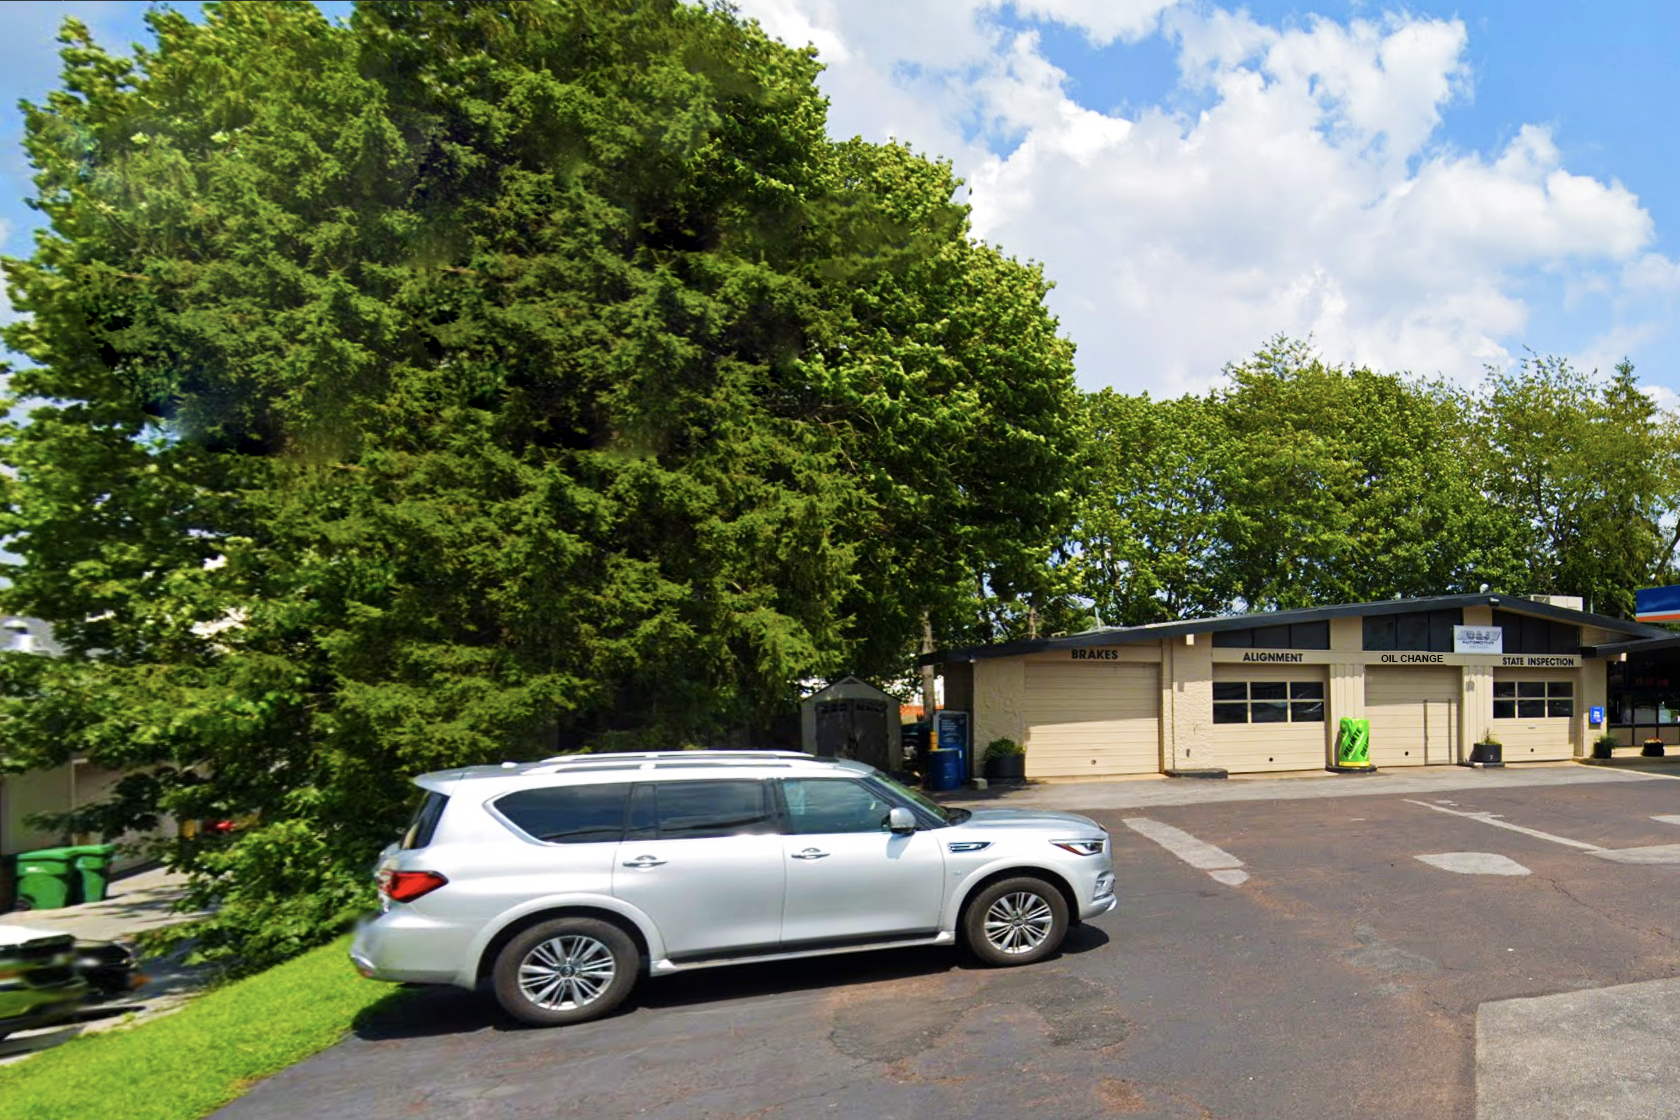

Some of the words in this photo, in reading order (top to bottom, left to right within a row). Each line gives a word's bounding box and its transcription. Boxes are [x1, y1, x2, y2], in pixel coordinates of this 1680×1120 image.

[1071, 649, 1119, 660] BRAKES
[1243, 652, 1303, 662] ALIGNMENT
[1381, 655, 1398, 663] OIL
[1400, 655, 1444, 663] CHANGE
[1502, 656, 1524, 665] STATE
[1527, 657, 1574, 666] INSPECTION
